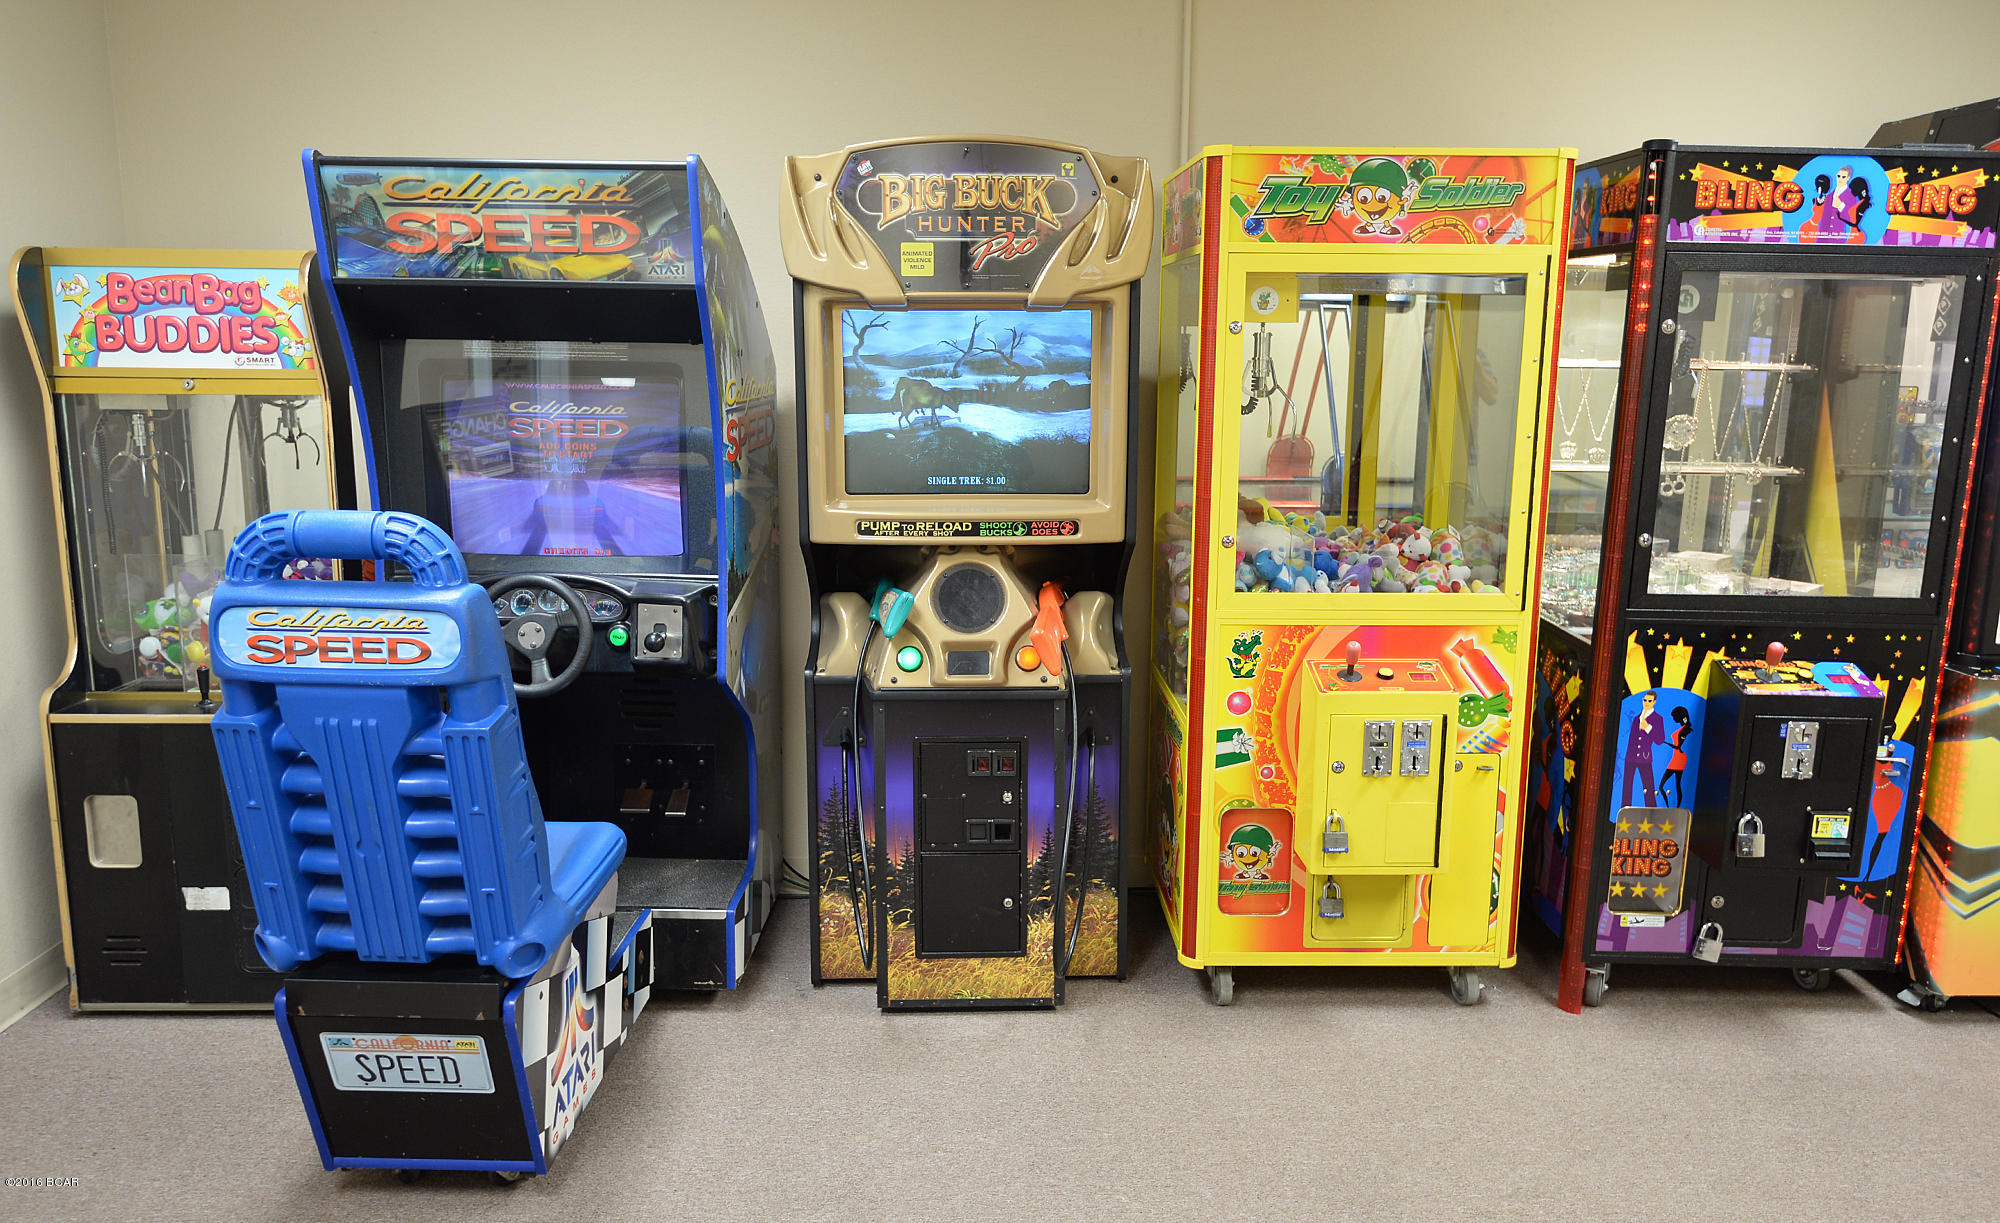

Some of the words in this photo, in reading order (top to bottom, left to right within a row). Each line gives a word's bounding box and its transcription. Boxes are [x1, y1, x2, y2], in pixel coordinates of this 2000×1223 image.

[382, 172, 633, 213] California
[878, 174, 947, 230] BIG
[952, 174, 1060, 230] BUCK
[1255, 175, 1346, 224] Toy
[1408, 176, 1525, 212] Soldier
[1600, 182, 1638, 215] KING
[1695, 180, 1804, 213] BLING
[1886, 183, 1978, 215] KING
[384, 211, 642, 255] SPEED
[918, 216, 1027, 233] HUNTER
[970, 232, 1038, 271] Pro
[648, 264, 685, 275] ATARI
[95, 314, 280, 353] BUDDIES
[726, 373, 775, 413] California
[509, 400, 628, 419] California
[508, 418, 629, 438] SPEED
[727, 408, 775, 463] SPEED
[540, 442, 560, 450] ADD
[564, 442, 597, 450] COINS
[560, 451, 593, 459] START
[928, 476, 957, 485] SINGLE
[959, 476, 984, 485] TREK:
[986, 476, 1006, 485] $1.00
[861, 521, 900, 531] PUMP
[916, 521, 972, 531] RELOAD
[1031, 521, 1060, 529] AVOID
[543, 547, 588, 555] CREDITS
[247, 608, 429, 636] California
[247, 635, 432, 664] SPEED
[1614, 837, 1678, 858] BLING
[1611, 856, 1671, 877] KING
[355, 1038, 449, 1050] CALIFORNIA
[355, 1053, 461, 1084] SPEED
[553, 1030, 596, 1130] ATARI
[552, 1067, 597, 1145] GAMES
